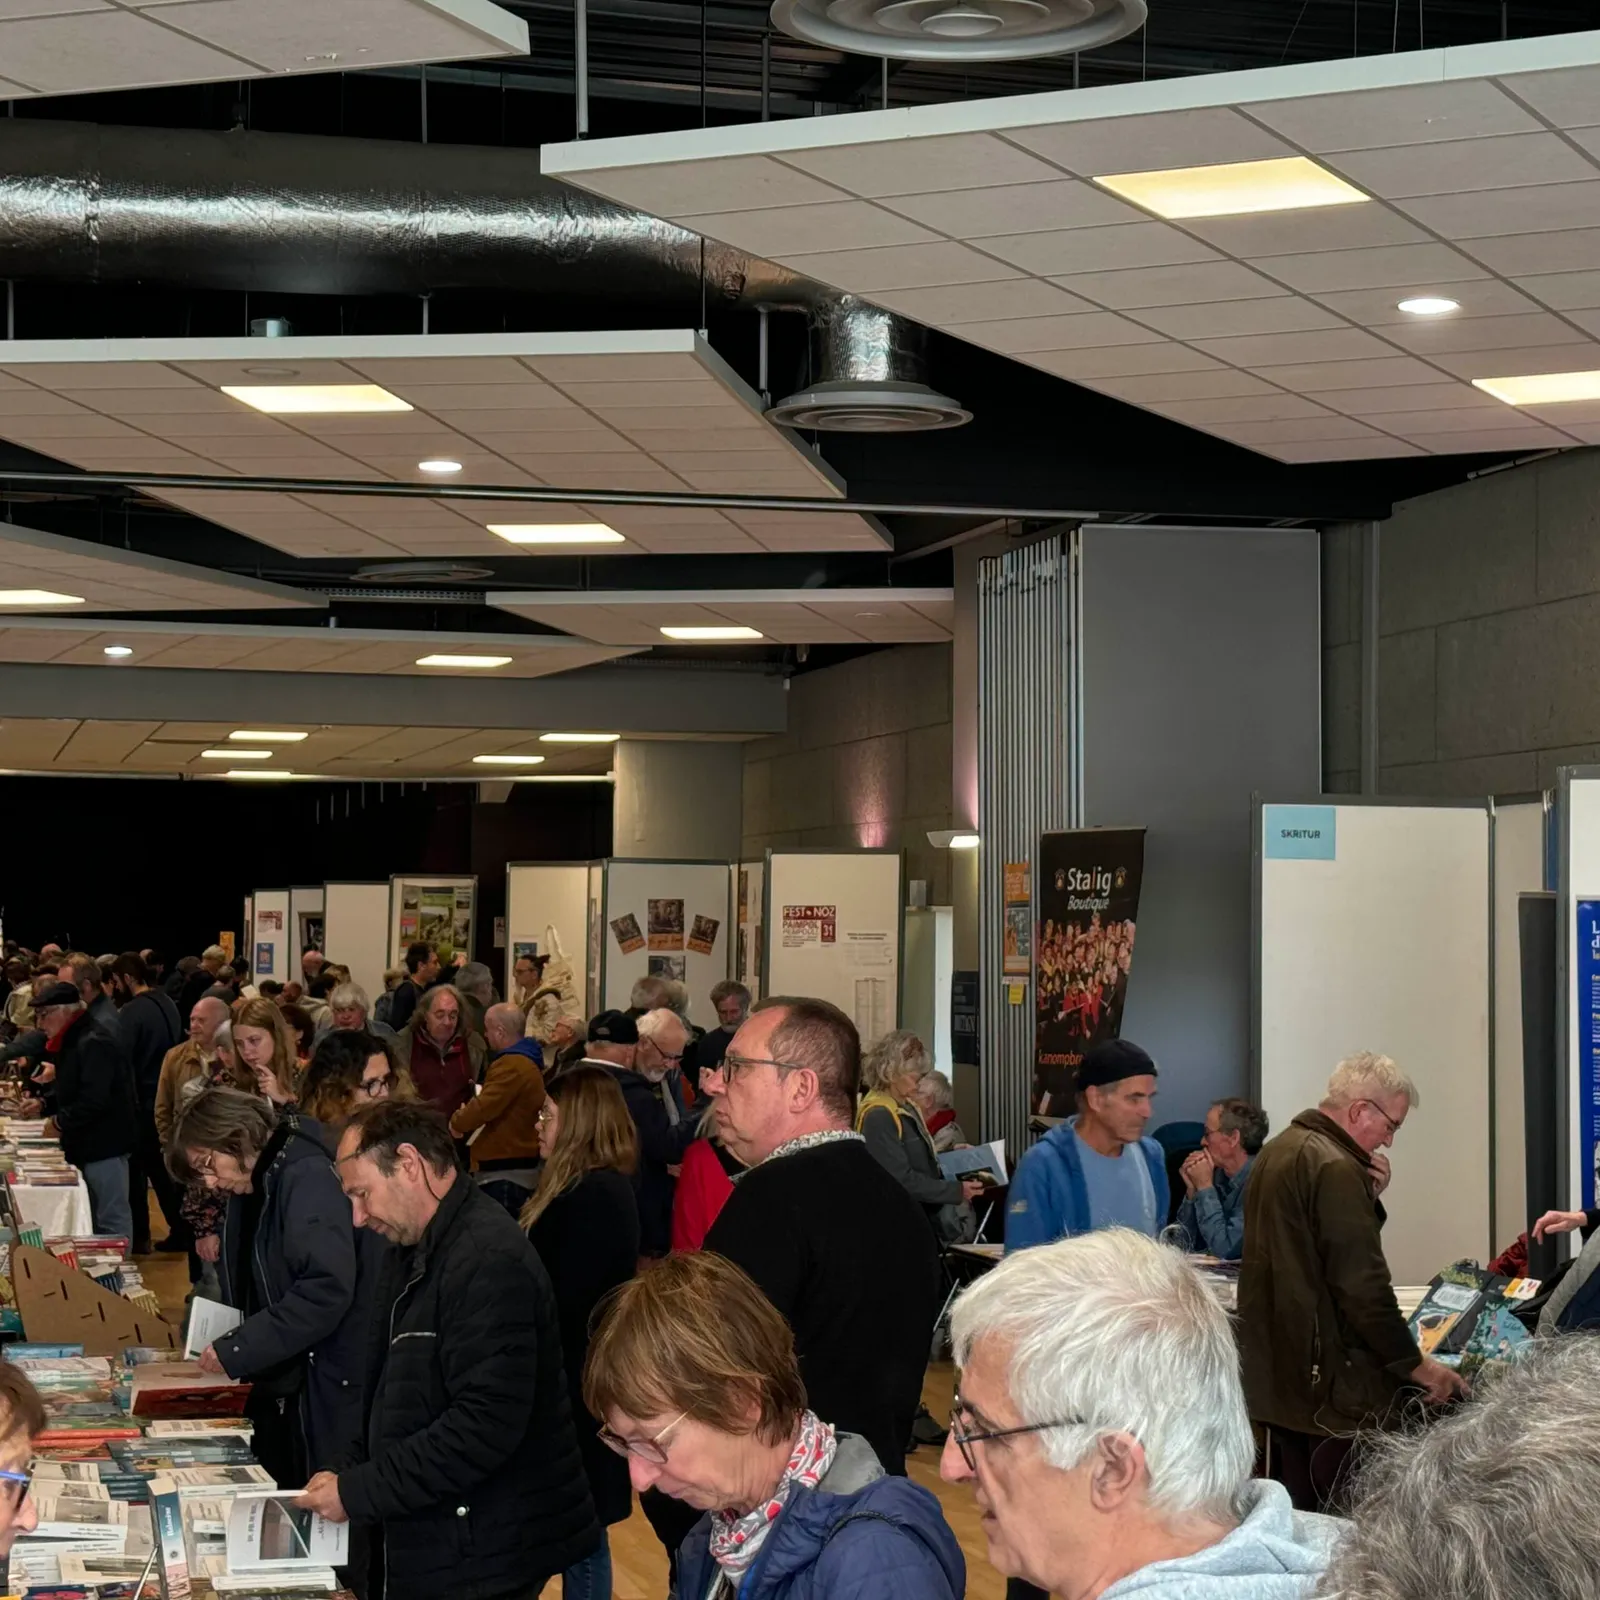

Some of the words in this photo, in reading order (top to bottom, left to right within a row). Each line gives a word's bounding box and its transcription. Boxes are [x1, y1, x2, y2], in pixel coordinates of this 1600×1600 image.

[1280, 829, 1321, 839] SKRITUR
[1067, 866, 1112, 896] Stalig
[783, 906, 805, 917] FEST
[813, 906, 835, 917] NOZ
[1067, 894, 1110, 914] Boutique
